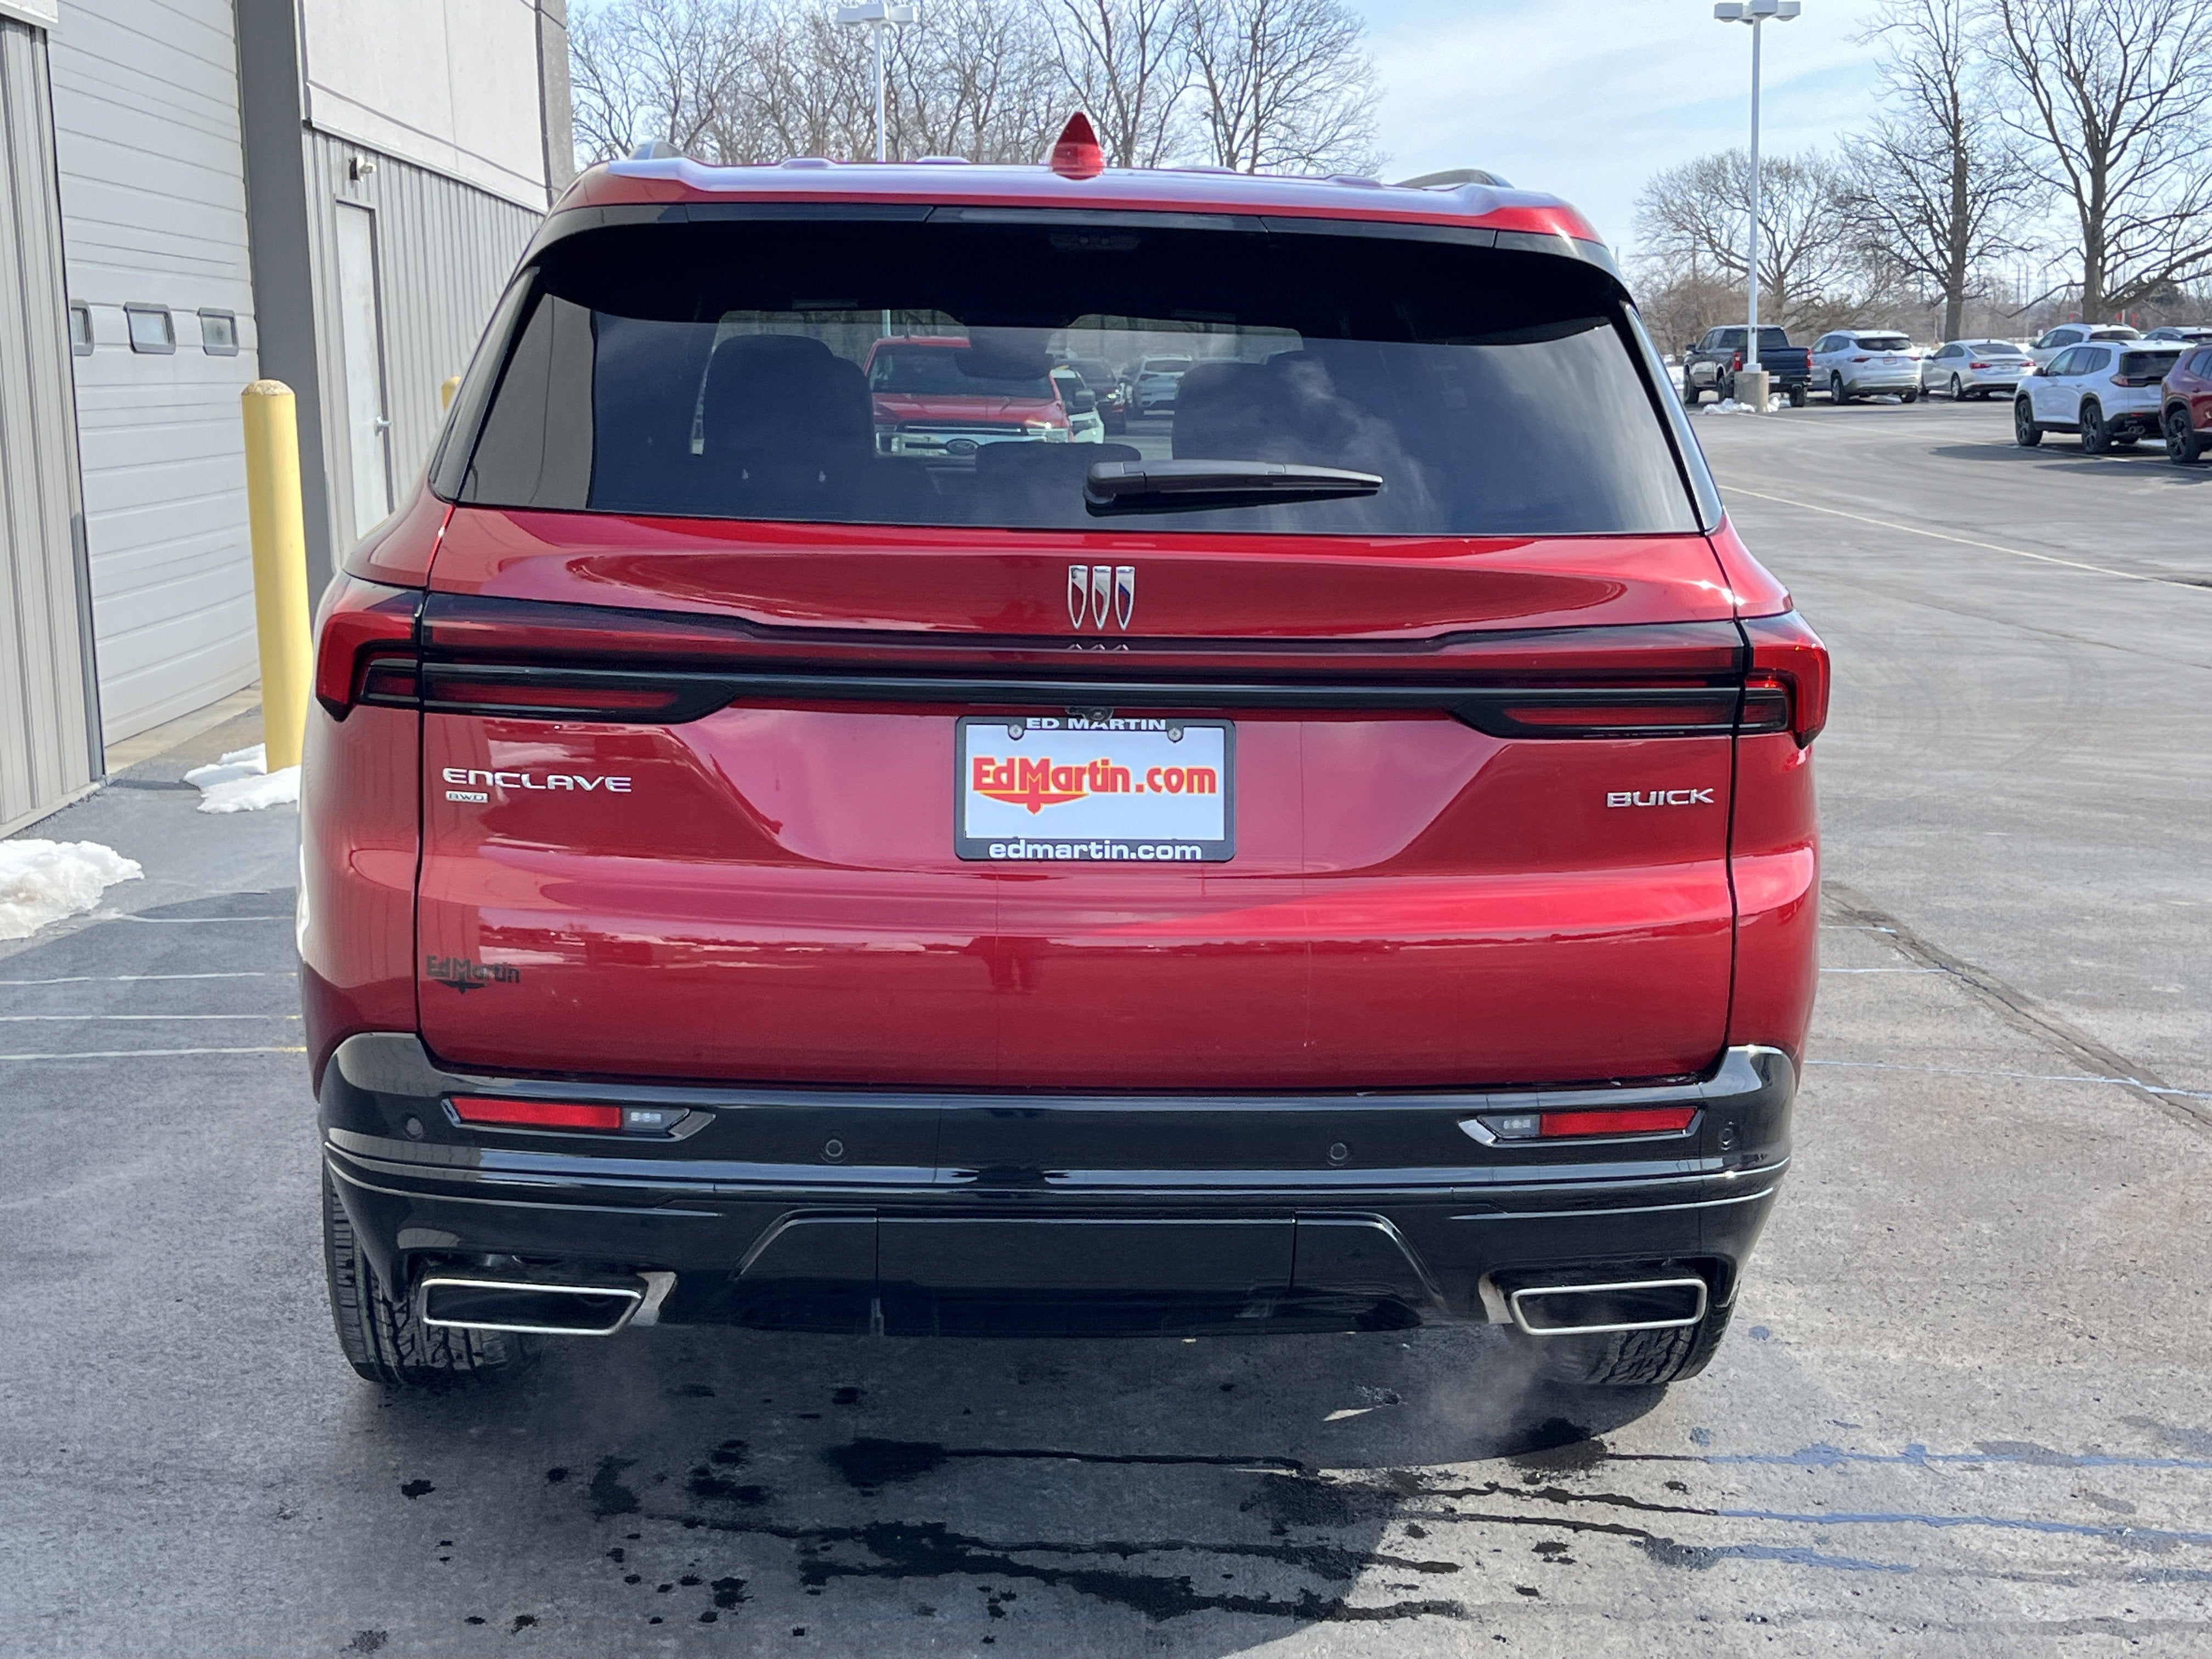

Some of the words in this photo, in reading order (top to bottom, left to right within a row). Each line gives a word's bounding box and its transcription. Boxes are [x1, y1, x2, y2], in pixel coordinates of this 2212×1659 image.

[1026, 718, 1059, 729] ED
[1067, 718, 1166, 730] MARTIN
[973, 757, 1217, 794] EdMartin.com
[1607, 788, 1714, 808] BUICK
[989, 839, 1201, 860] edmartin.com
